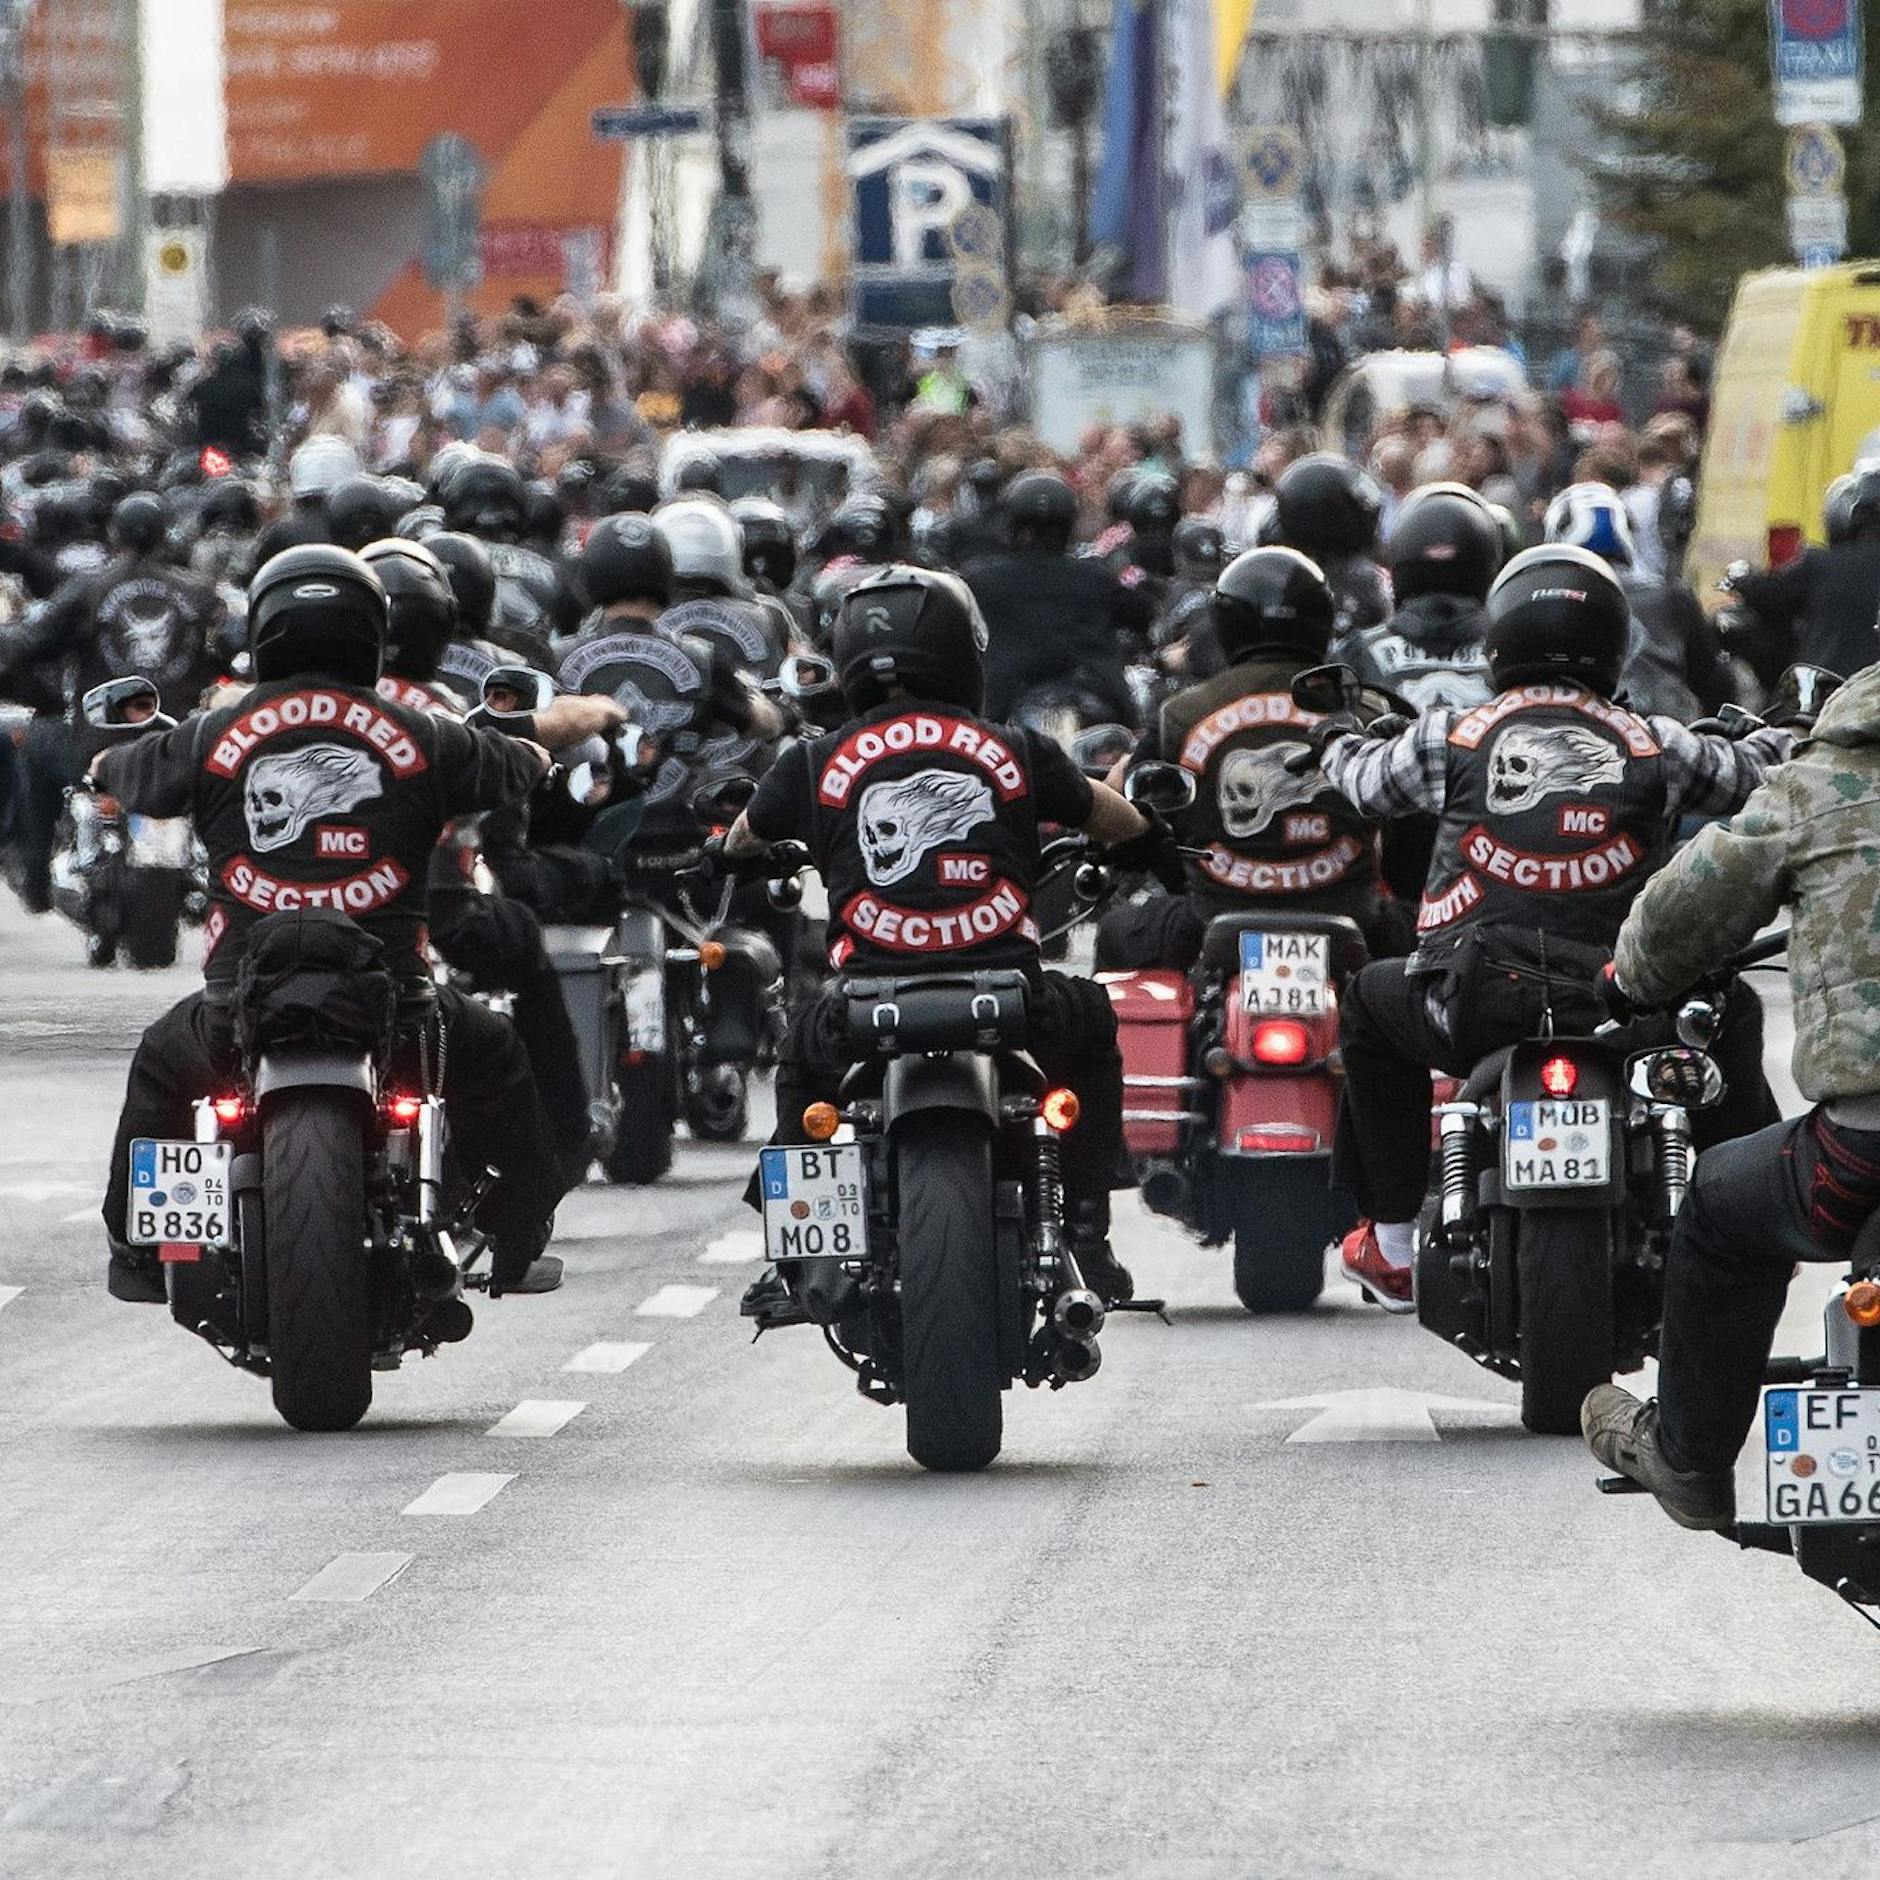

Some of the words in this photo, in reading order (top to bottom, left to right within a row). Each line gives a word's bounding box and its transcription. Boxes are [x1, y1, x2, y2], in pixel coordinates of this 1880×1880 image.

[889, 163, 972, 264] P
[213, 694, 338, 772] BLOOD
[343, 703, 419, 768] RED
[1184, 695, 1292, 764] BLOOD
[820, 719, 944, 800] BLOOD
[950, 723, 1023, 791] RED
[1287, 816, 1328, 840] MC
[1562, 809, 1606, 834] MC
[320, 831, 367, 854] MC
[942, 859, 988, 882] MC
[1208, 841, 1356, 889] SECTION
[1468, 834, 1636, 889] SECTION
[230, 862, 402, 912] SECTION
[852, 885, 1022, 947] SECTION
[1267, 937, 1320, 959] MAK
[162, 1146, 203, 1174] HO
[801, 1149, 842, 1180] BT
[138, 1171, 150, 1184] D
[771, 1180, 782, 1195] D
[837, 1183, 858, 1197] 03
[206, 1194, 223, 1206] 10
[841, 1202, 860, 1216] 10
[781, 1224, 824, 1256] MO
[832, 1222, 852, 1253] 8
[1806, 1394, 1861, 1430] EF
[1776, 1428, 1792, 1446] D
